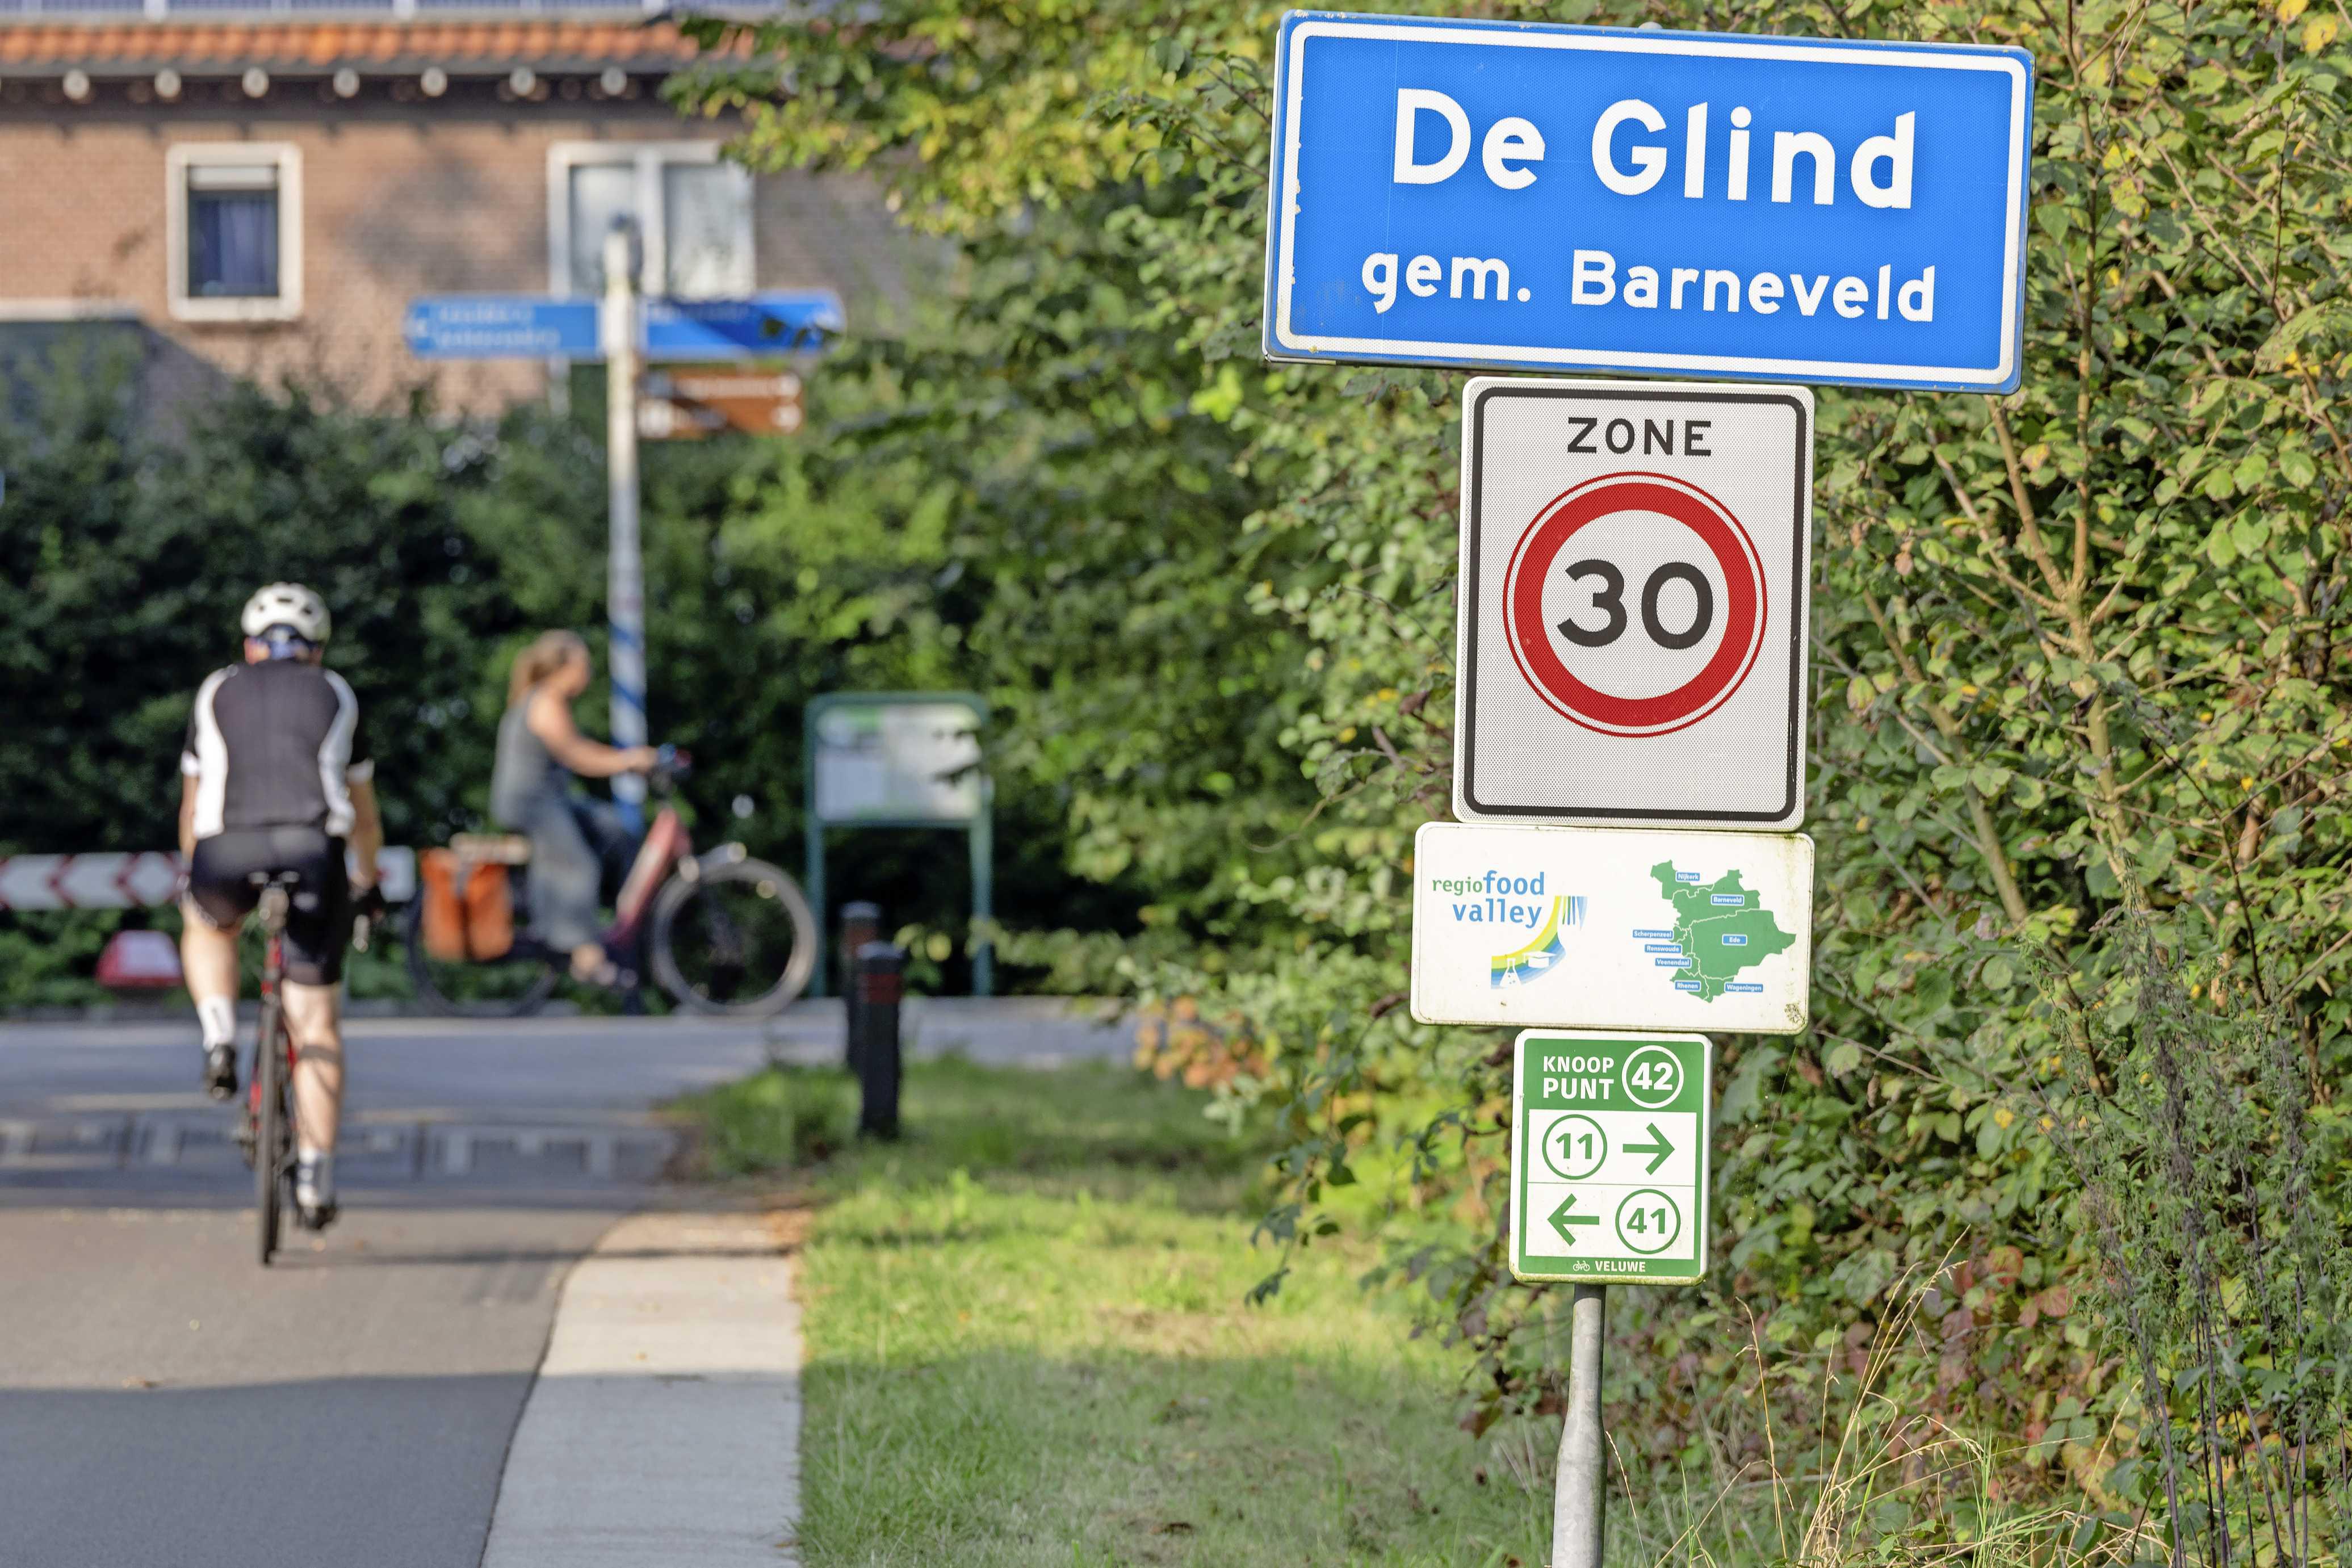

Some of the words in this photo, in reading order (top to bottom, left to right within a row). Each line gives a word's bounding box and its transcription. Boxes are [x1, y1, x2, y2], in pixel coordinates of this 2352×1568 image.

[1393, 87, 1545, 190] De
[1591, 98, 1915, 210] Glind
[1361, 250, 1532, 313] gem.
[1571, 249, 1935, 322] Barneveld
[1567, 417, 1712, 456] ZONE
[1557, 559, 1713, 649] 30
[1452, 898, 1542, 929] valley
[1542, 1055, 1615, 1074] KNOOP
[1631, 1062, 1674, 1091] 42
[1542, 1078, 1615, 1100] PUNT
[1556, 1133, 1593, 1160] 11
[1626, 1208, 1666, 1235] 41
[1595, 1260, 1646, 1272] VELUWE
